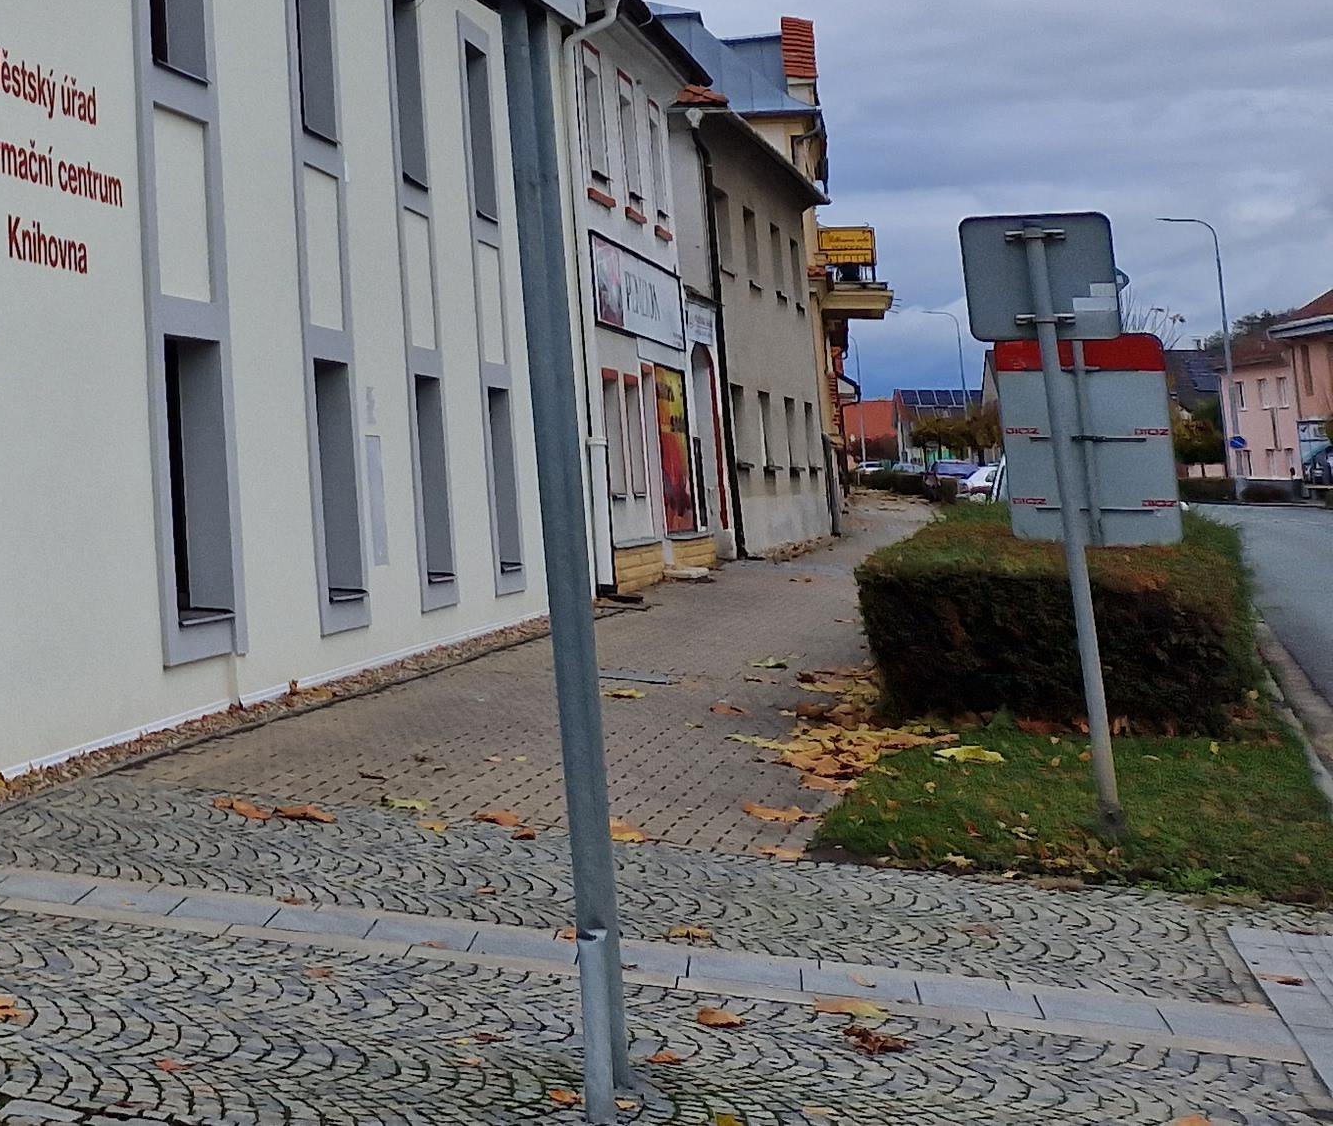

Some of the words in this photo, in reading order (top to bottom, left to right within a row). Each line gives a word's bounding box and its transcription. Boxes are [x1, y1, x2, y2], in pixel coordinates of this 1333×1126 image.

[61, 74, 97, 125] úřad
[58, 161, 123, 208] centrum
[8, 214, 88, 274] Knihovna
